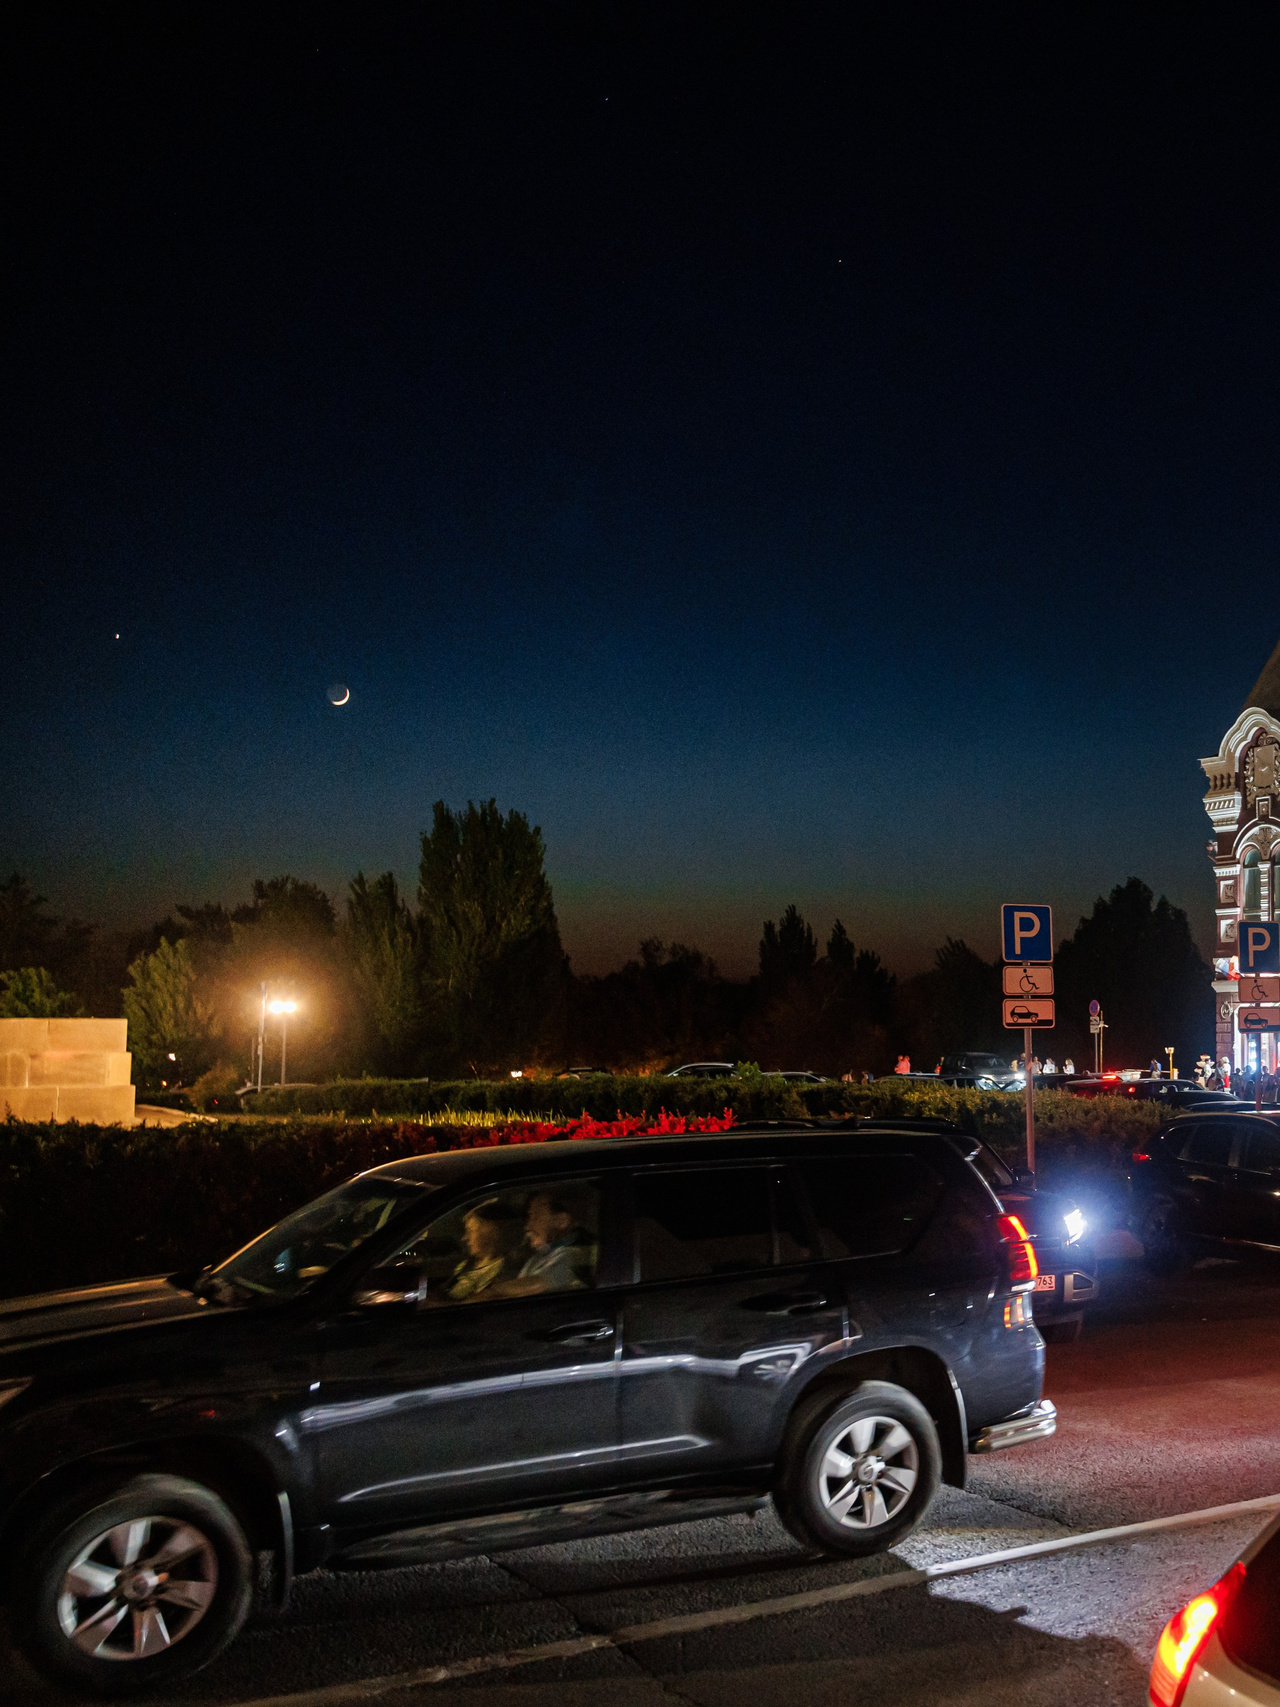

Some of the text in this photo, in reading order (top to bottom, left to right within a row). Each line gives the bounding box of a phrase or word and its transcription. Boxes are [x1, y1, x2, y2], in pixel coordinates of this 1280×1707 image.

[1014, 911, 1040, 955] P
[1248, 927, 1271, 967] P
[1037, 1276, 1053, 1286] 763
